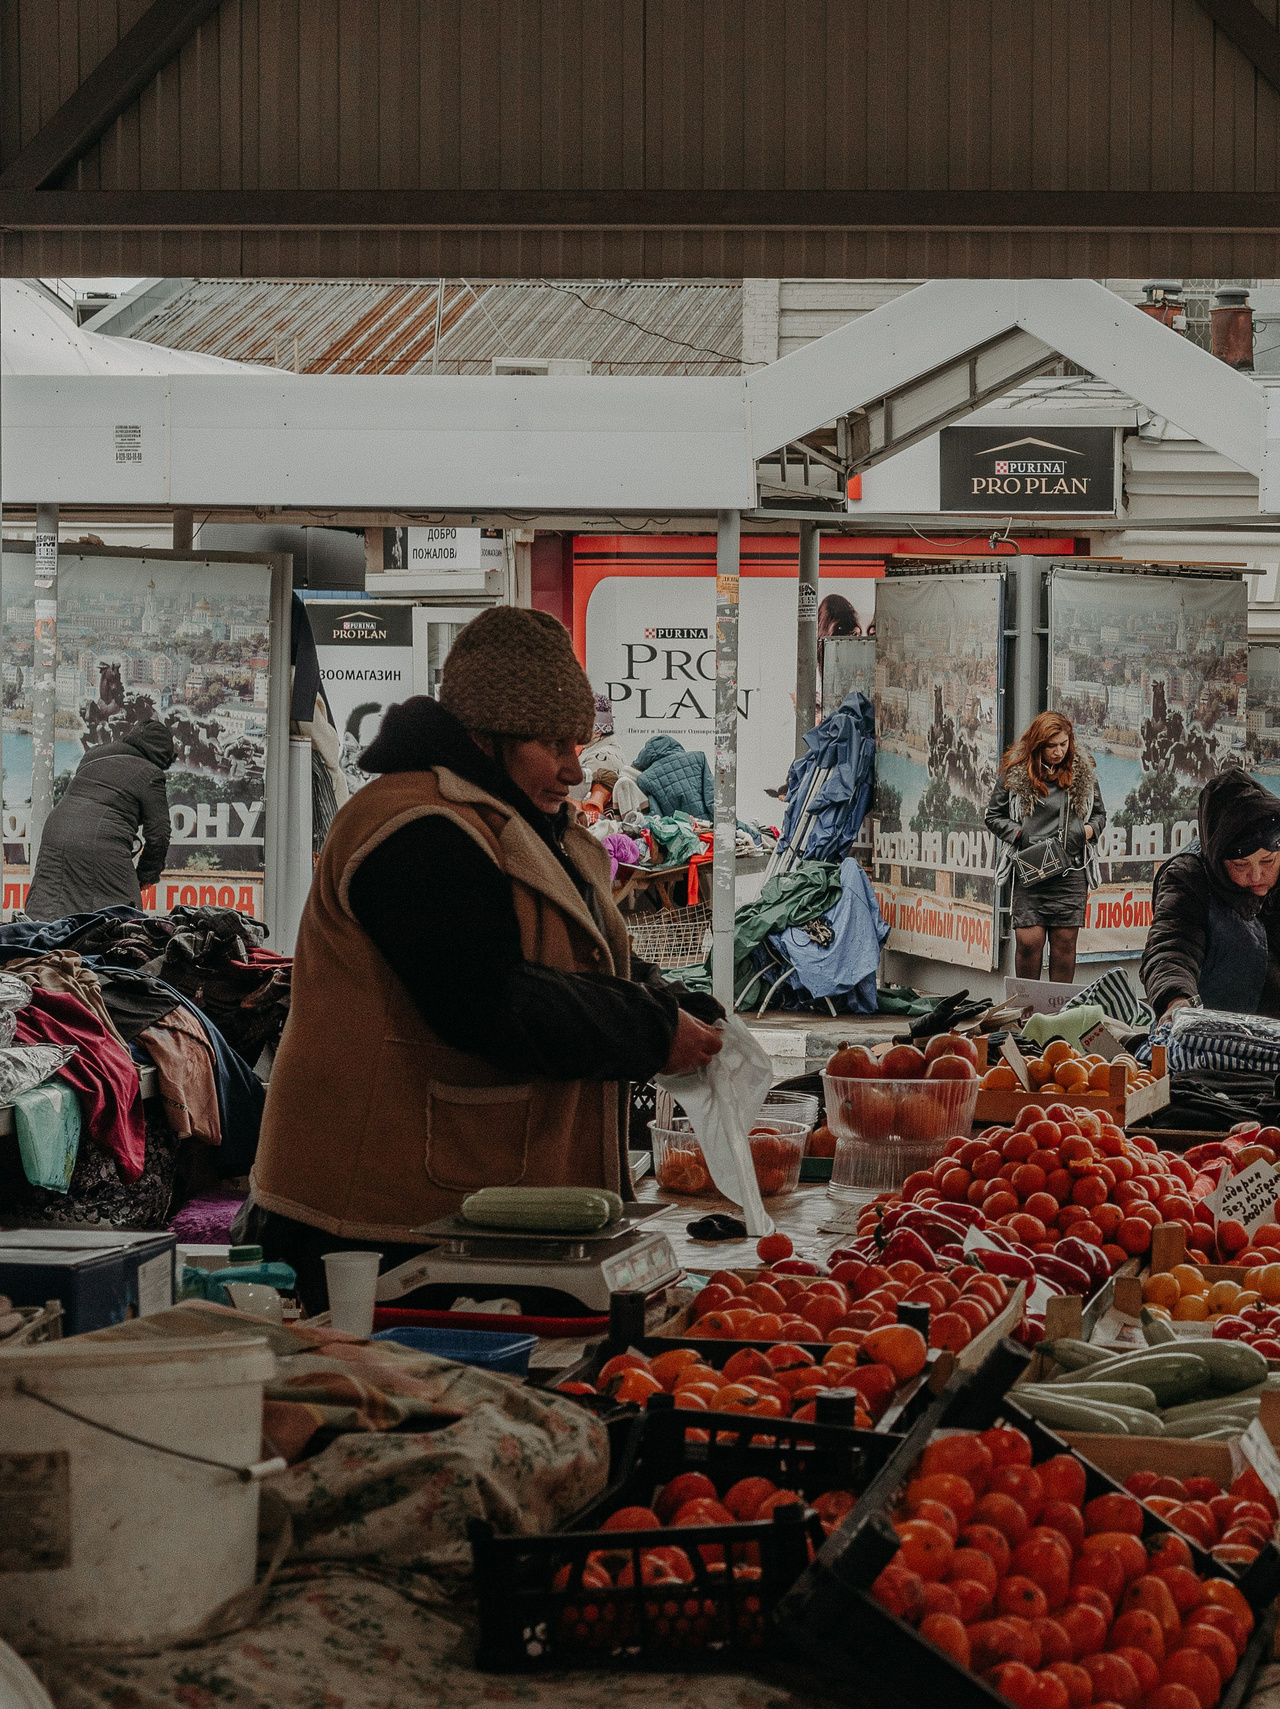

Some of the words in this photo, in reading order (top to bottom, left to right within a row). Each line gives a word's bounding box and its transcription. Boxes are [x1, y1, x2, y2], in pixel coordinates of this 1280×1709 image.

[1009, 463, 1062, 473] PURINA
[971, 478, 1021, 494] PRO
[1025, 478, 1088, 494] PLAN
[427, 528, 457, 541] ДОБРО
[412, 548, 457, 559] ПОЖАЛОВ
[332, 630, 356, 639] PRO
[357, 630, 387, 639] PLAN
[657, 629, 707, 639] PURINA
[319, 669, 401, 681] ЗООМАГАЗИН
[169, 802, 264, 838] ОНУ
[946, 830, 995, 870] ДОНУ
[899, 896, 954, 939] любимый
[956, 914, 991, 954] город
